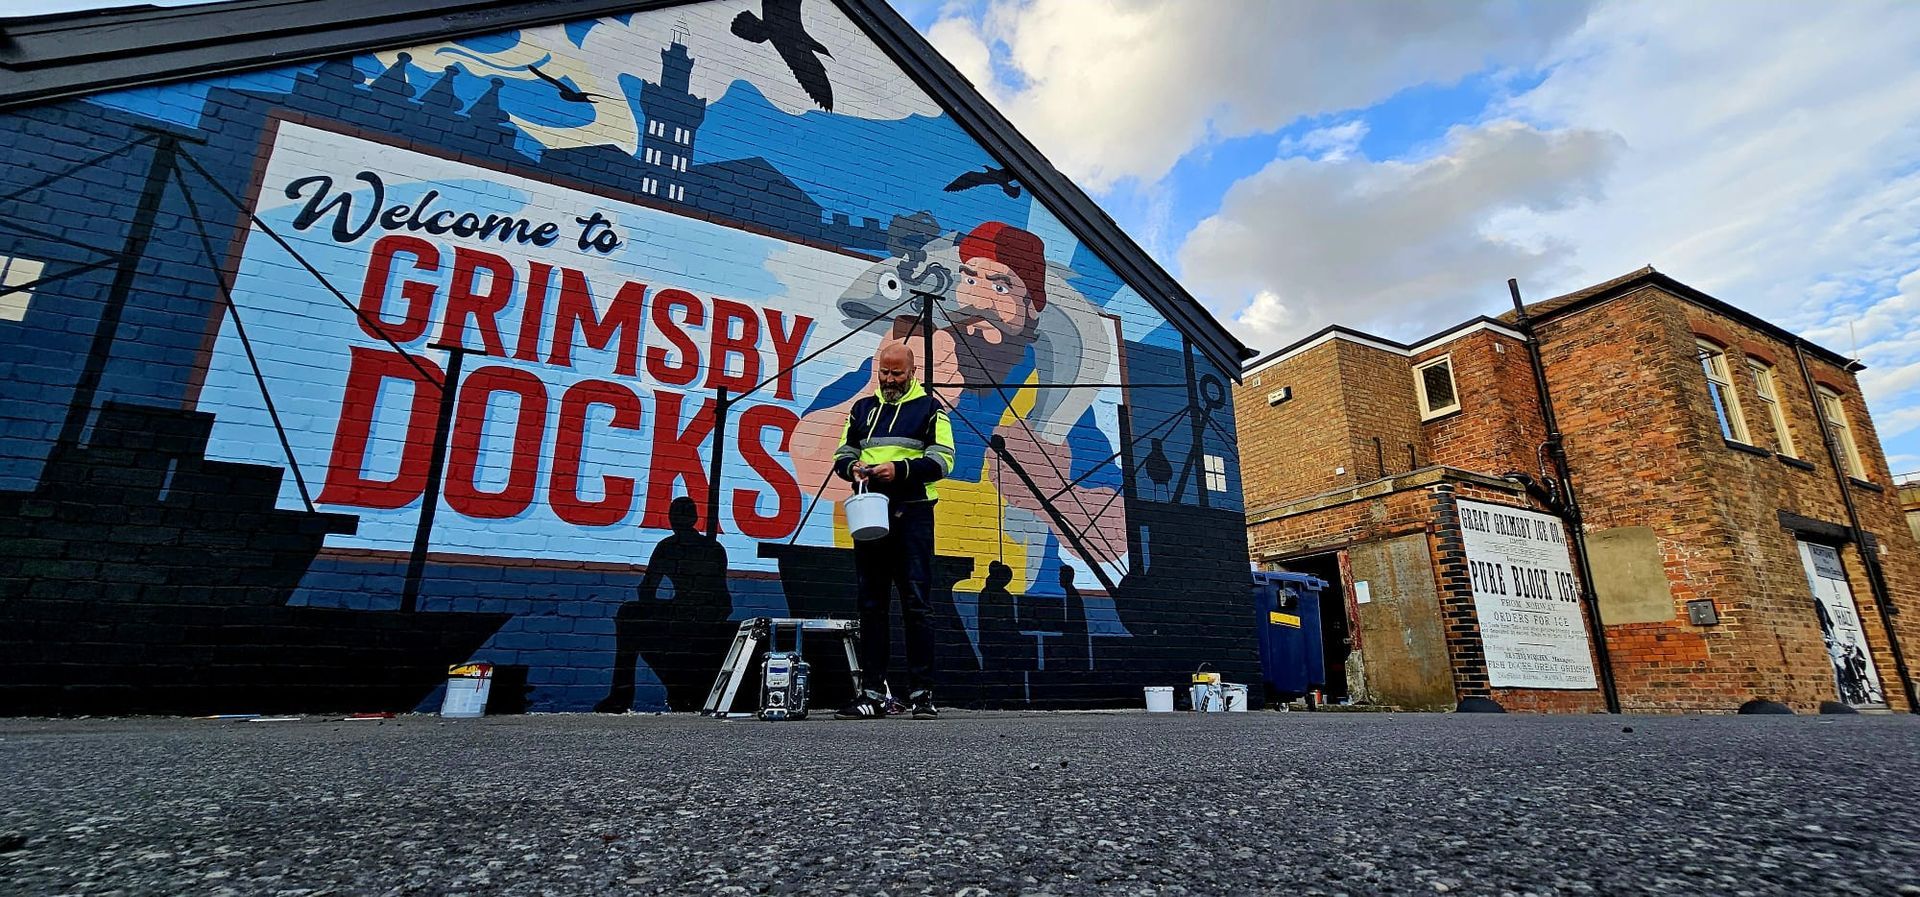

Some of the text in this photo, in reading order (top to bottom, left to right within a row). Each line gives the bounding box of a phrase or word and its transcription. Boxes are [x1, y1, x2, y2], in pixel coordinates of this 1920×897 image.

[284, 170, 624, 253] Welcome to
[356, 234, 815, 402] GRIMSBY
[316, 345, 804, 540] DOCKS
[1461, 507, 1491, 533] GREAT
[1493, 513, 1532, 540] GRIMSBY
[1533, 519, 1548, 542] ICE
[1469, 559, 1577, 603] PURE BLOCK ICE
[1493, 611, 1570, 627] ORDERS FOR ICE
[1500, 598, 1557, 612] FROM NORWAY
[1487, 660, 1506, 669] FISH
[1534, 662, 1559, 672] GREAT
